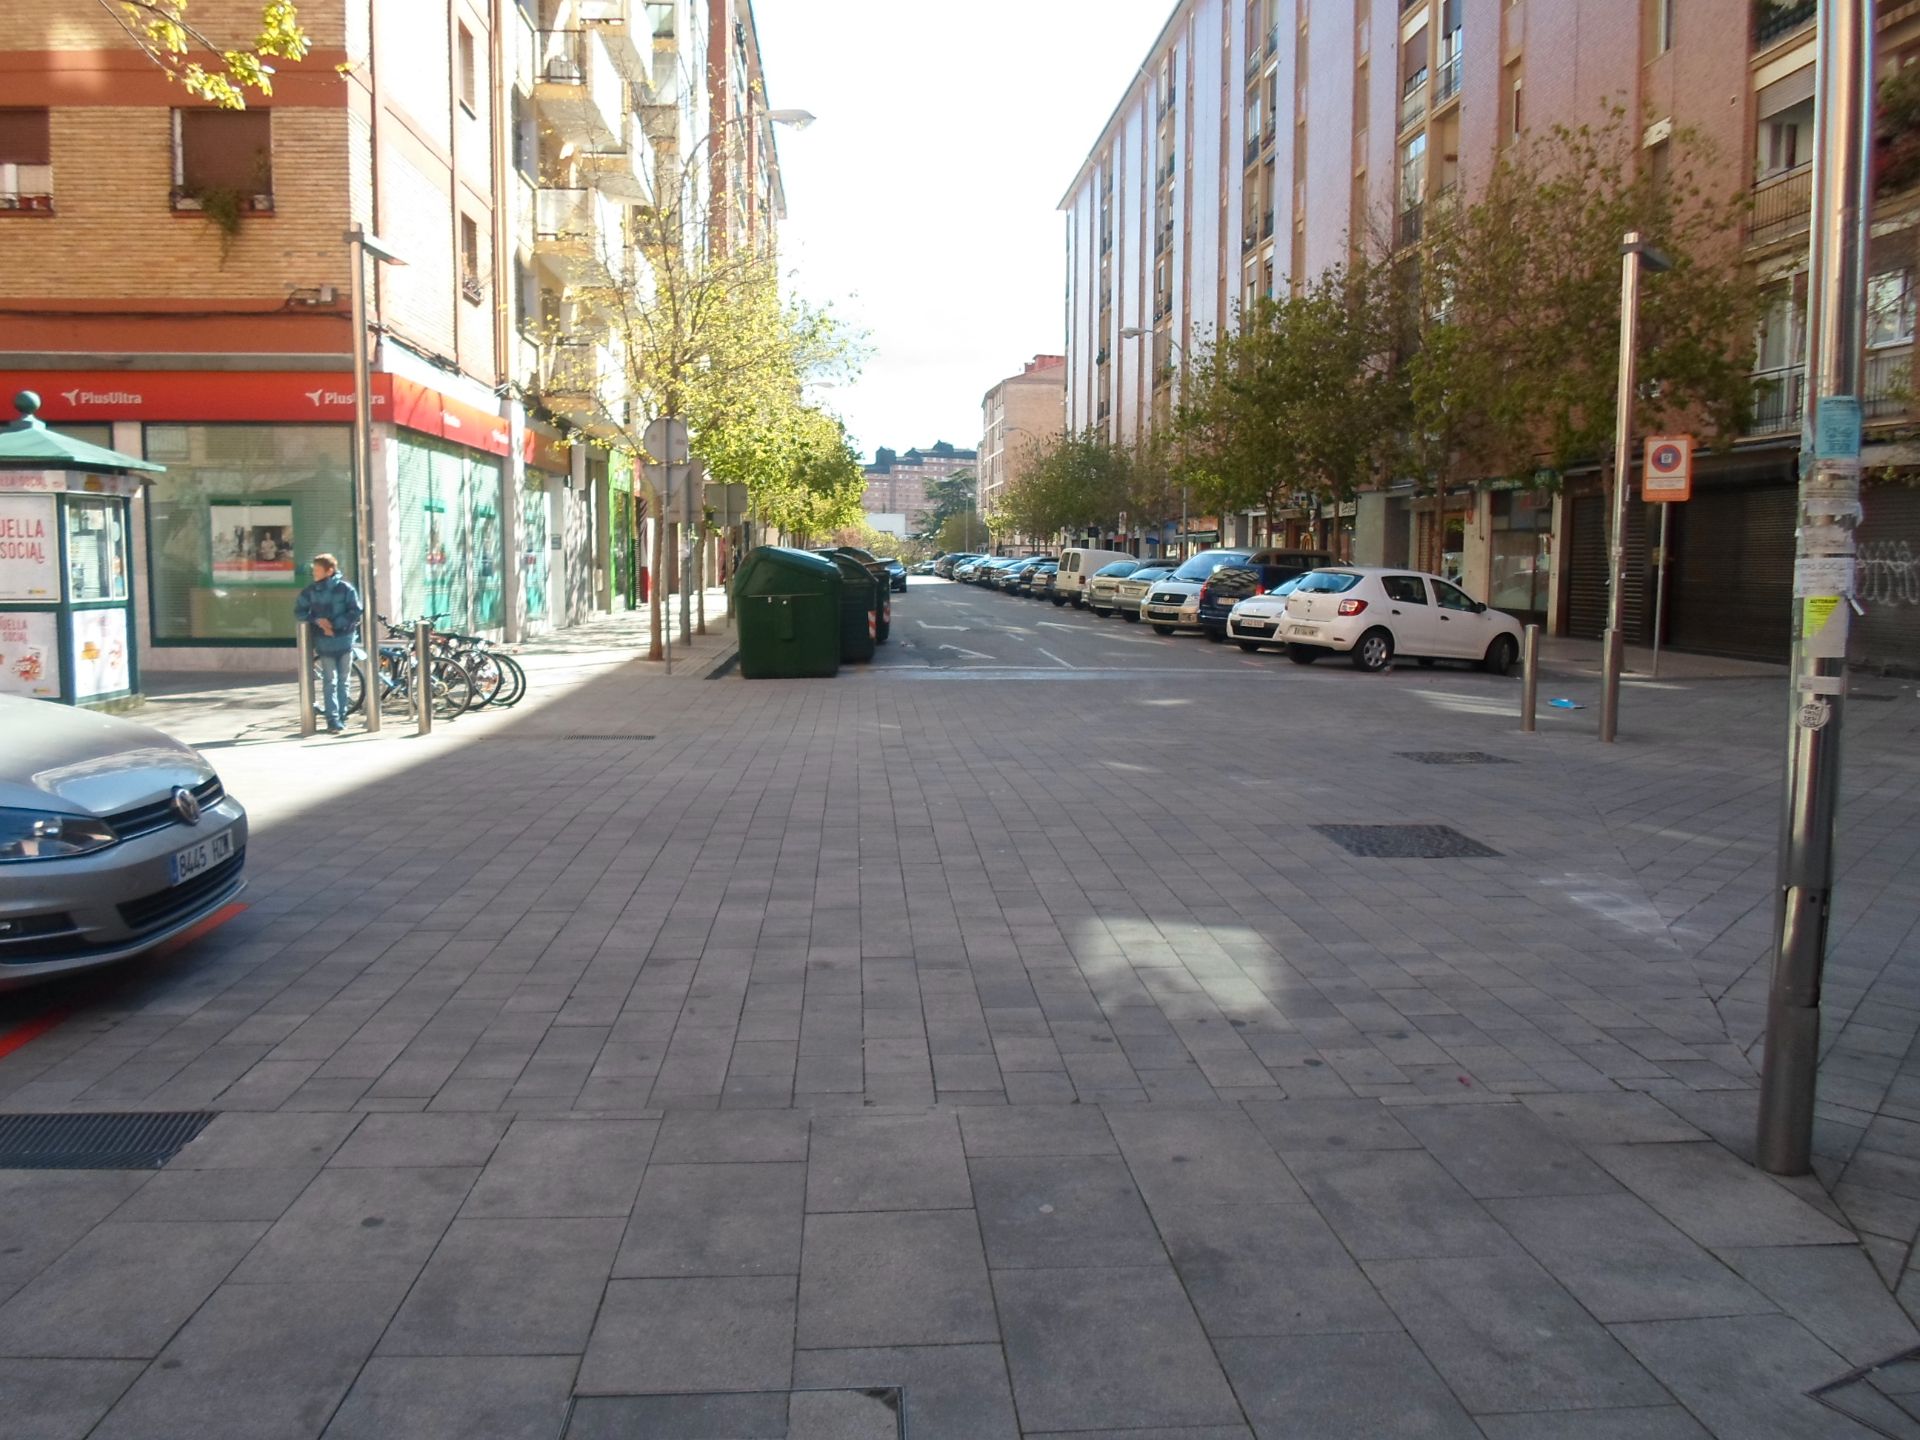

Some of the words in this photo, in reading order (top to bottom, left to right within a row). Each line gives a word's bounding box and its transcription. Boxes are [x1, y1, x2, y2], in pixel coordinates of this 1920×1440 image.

[80, 391, 142, 405] PlusUltra
[324, 391, 385, 405] Plusra
[0, 542, 45, 564] SOCIAL
[180, 845, 207, 878] 8445
